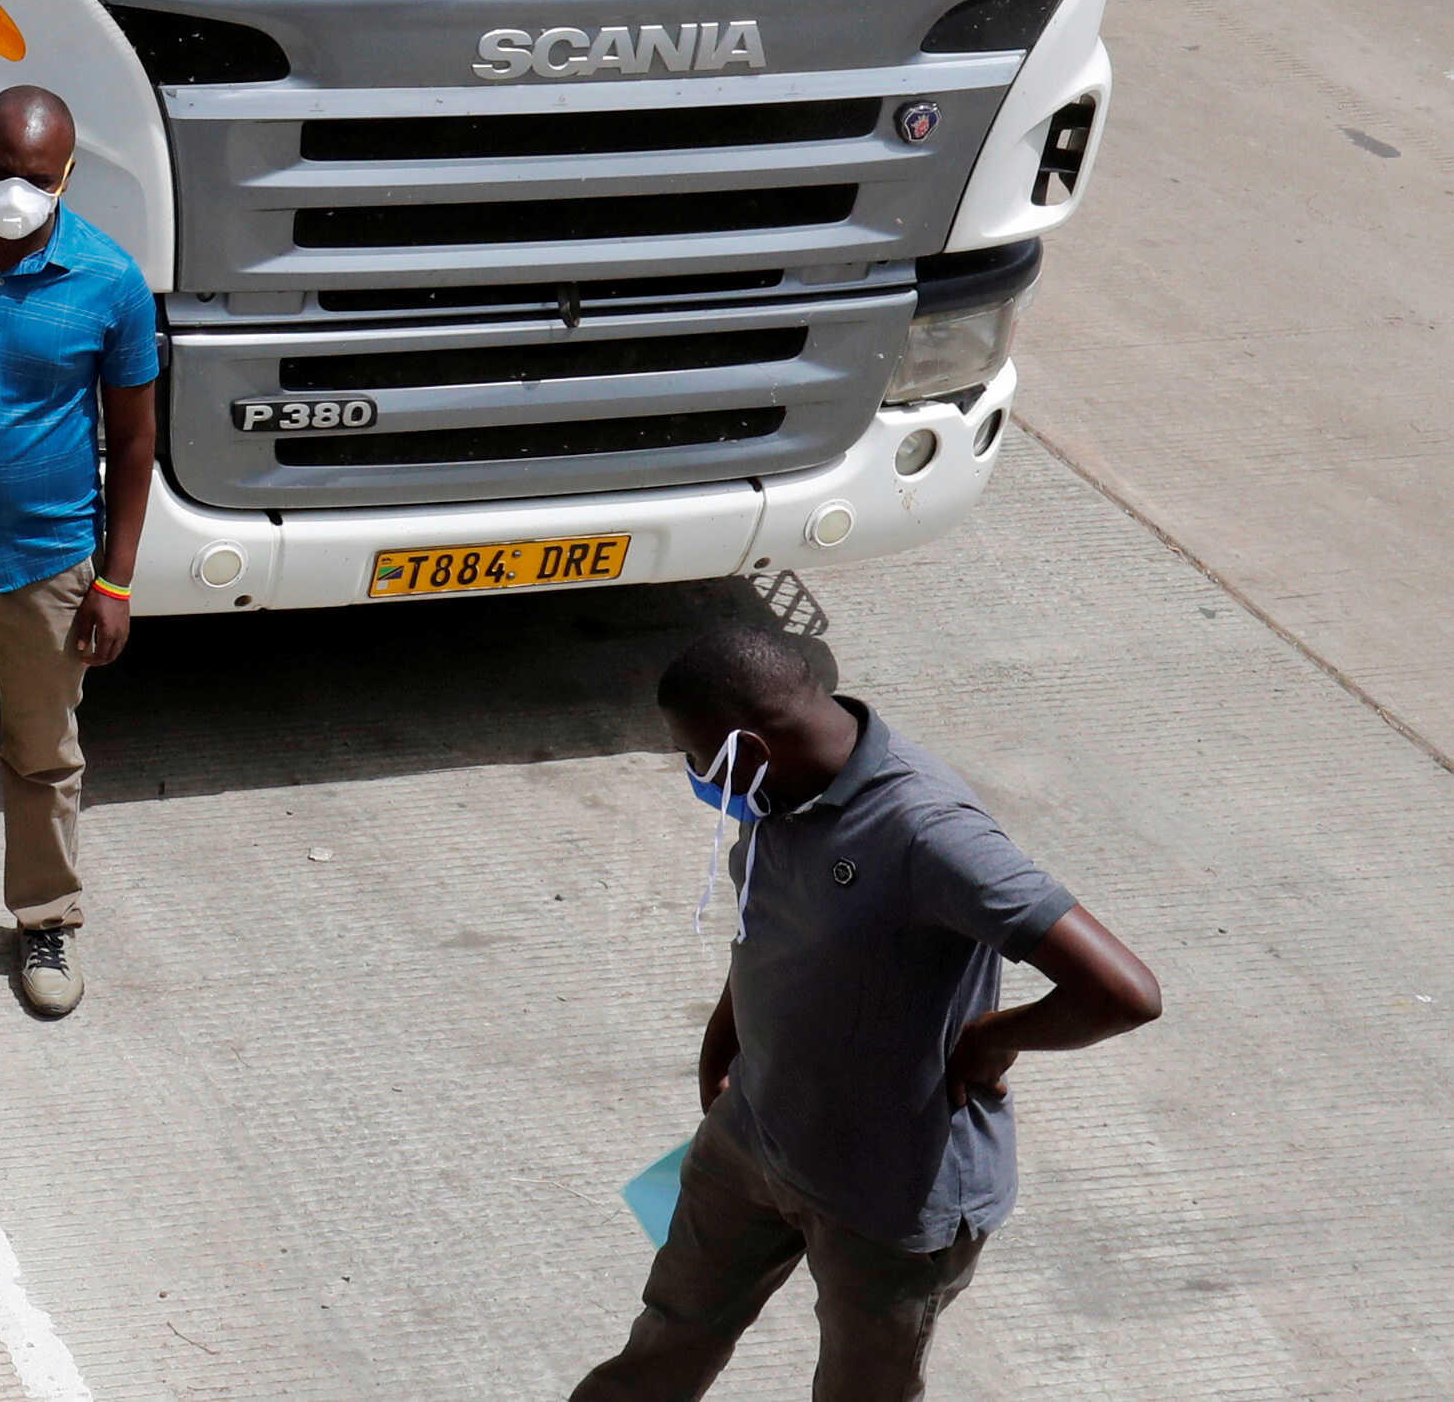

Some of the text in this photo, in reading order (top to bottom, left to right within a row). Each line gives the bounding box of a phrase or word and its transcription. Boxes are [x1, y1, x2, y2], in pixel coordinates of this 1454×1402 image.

[471, 19, 768, 81] SCANIA
[406, 541, 618, 590] T884 DRE
